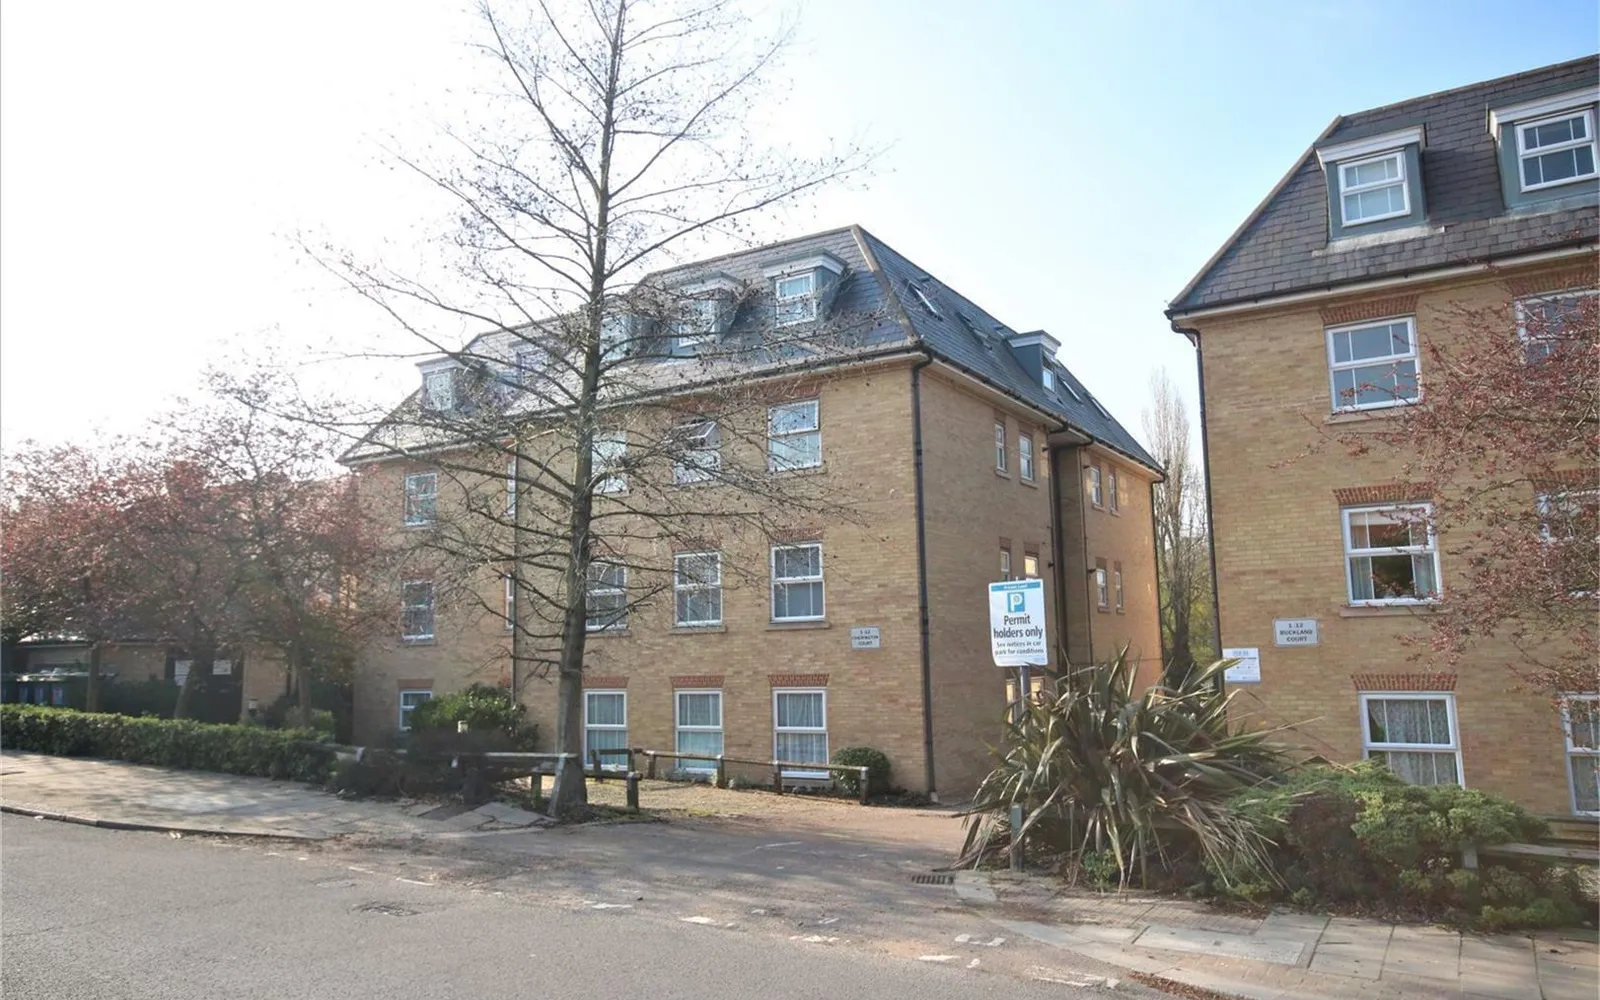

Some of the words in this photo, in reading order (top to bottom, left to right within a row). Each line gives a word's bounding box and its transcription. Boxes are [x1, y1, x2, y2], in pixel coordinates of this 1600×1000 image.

[1004, 613, 1031, 625] Permit
[993, 627, 1024, 639] holders
[1025, 626, 1043, 640] only
[995, 649, 1007, 657] park
[1017, 647, 1044, 655] conditions
